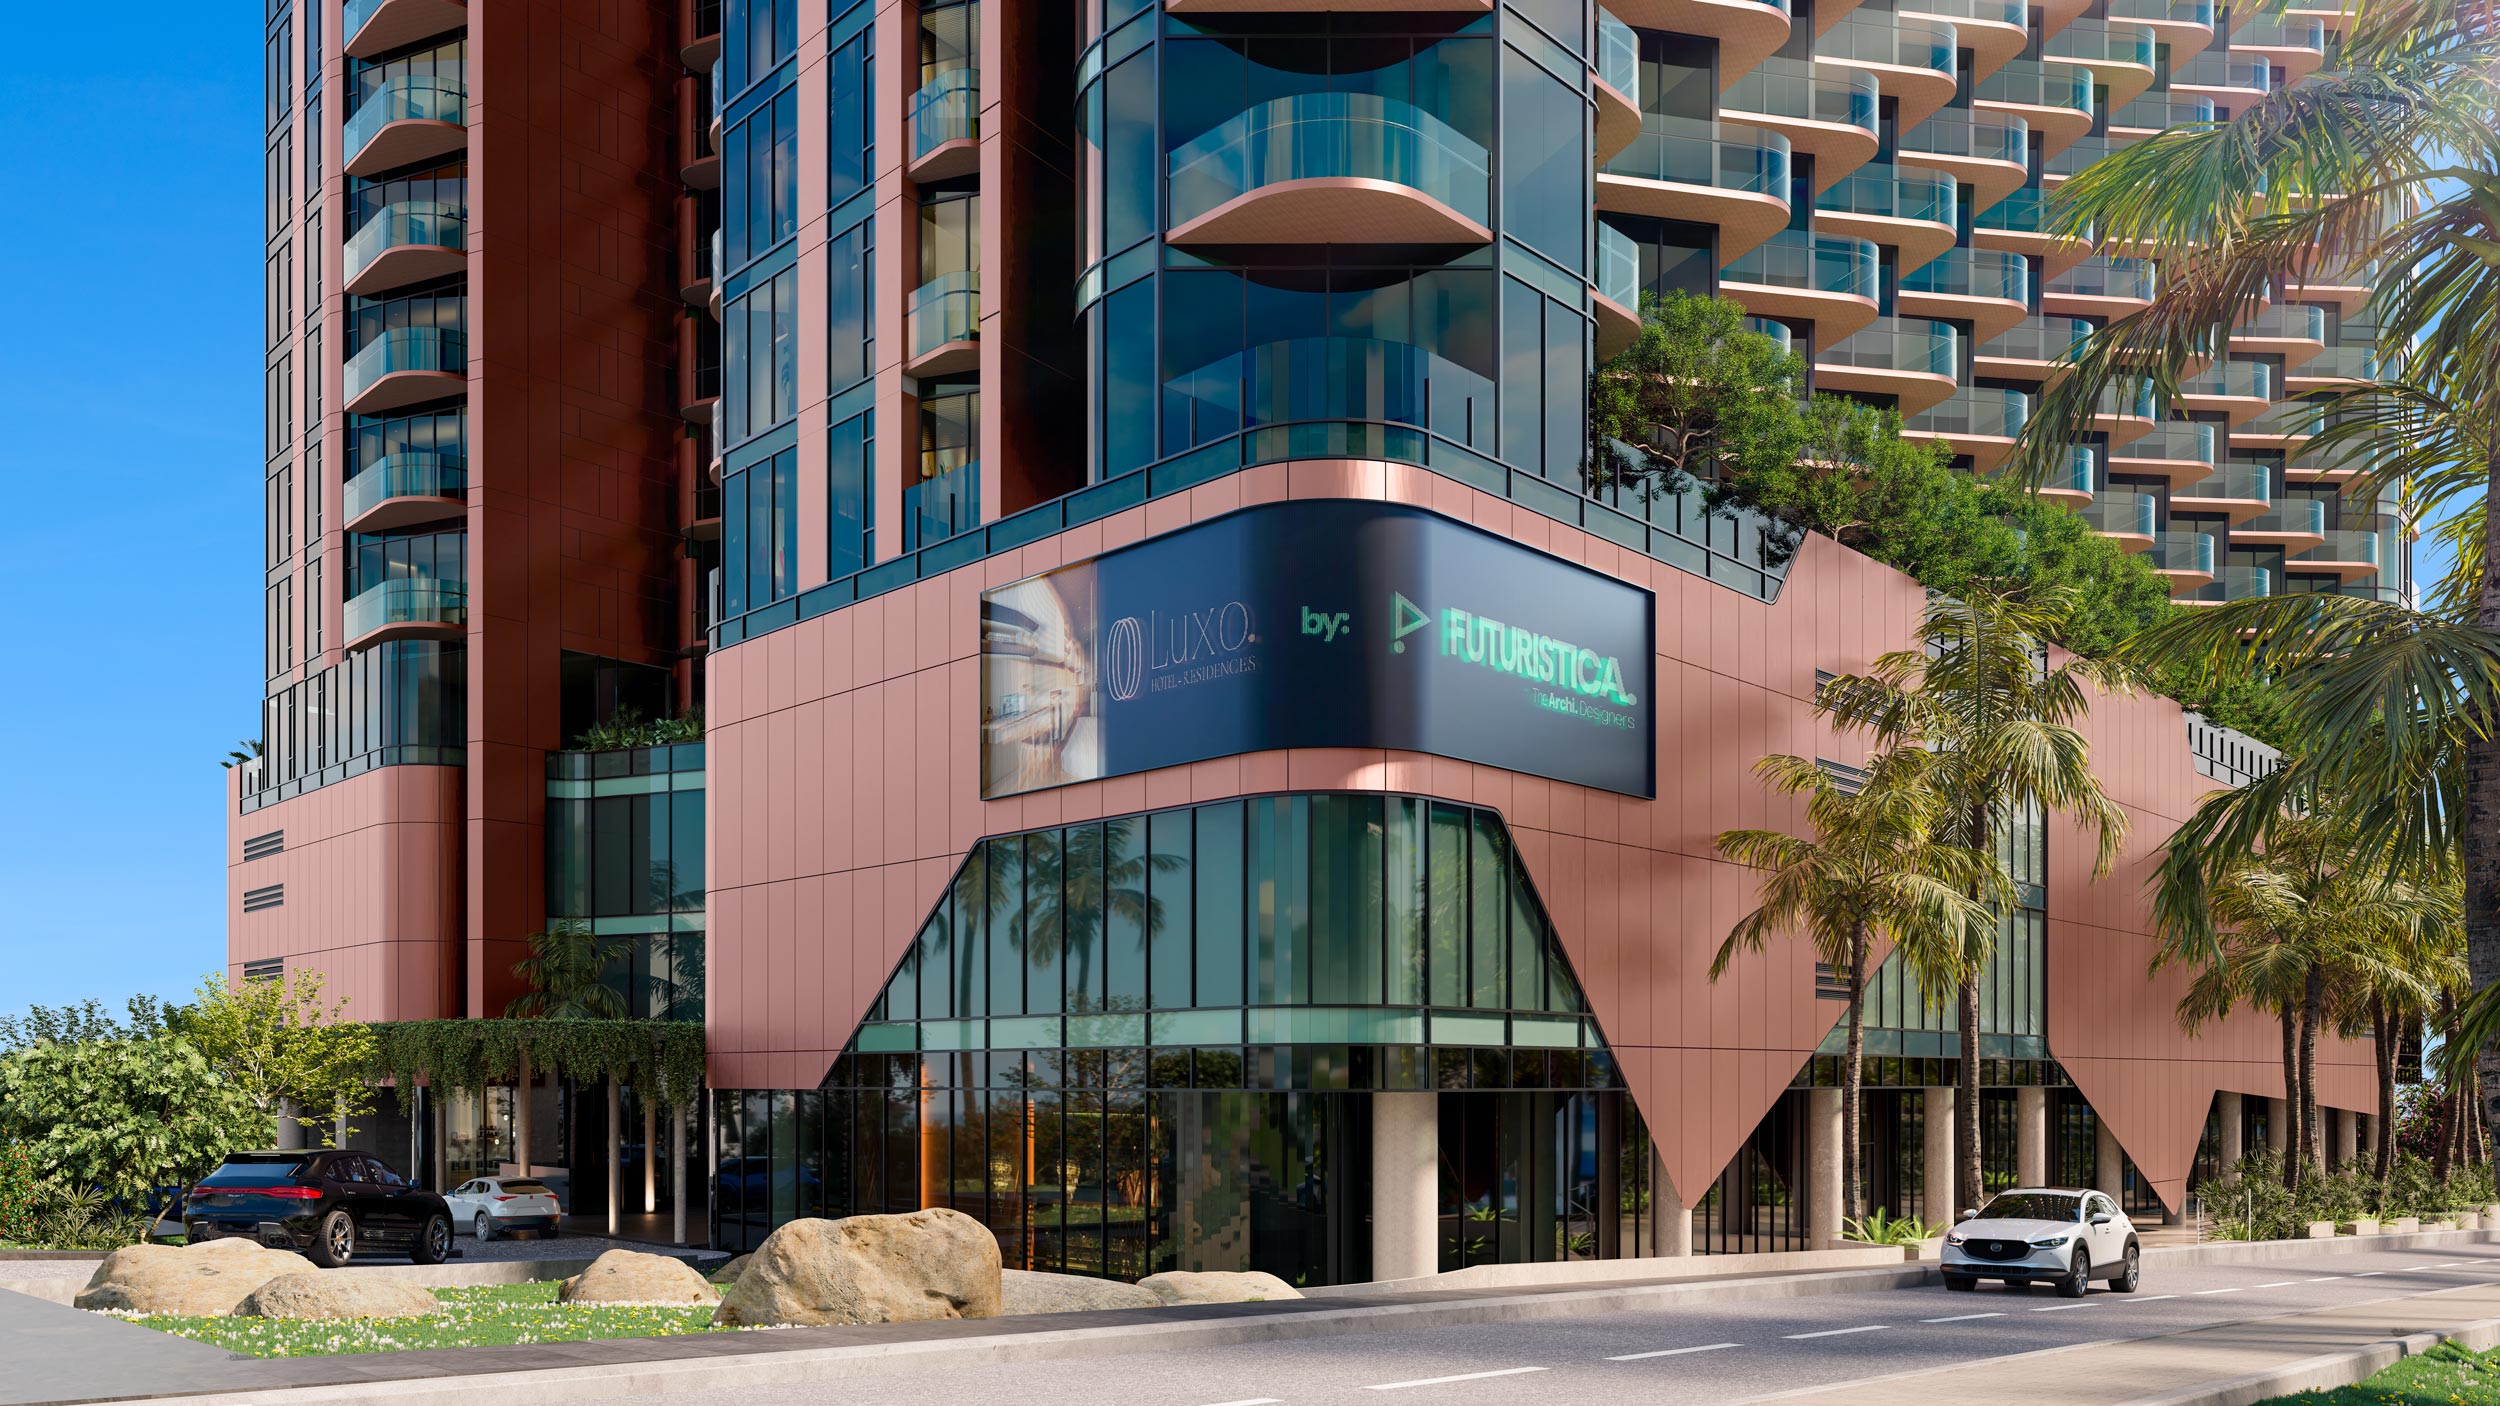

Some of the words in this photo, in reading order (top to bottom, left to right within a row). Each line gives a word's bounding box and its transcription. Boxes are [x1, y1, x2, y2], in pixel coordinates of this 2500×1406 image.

[1301, 605, 1350, 642] by:
[1183, 655, 1256, 686] RESIDENCES
[1448, 607, 1638, 706] FUTURISTICA.
[1548, 692, 1579, 715] Archi.
[1580, 700, 1636, 729] Designers
